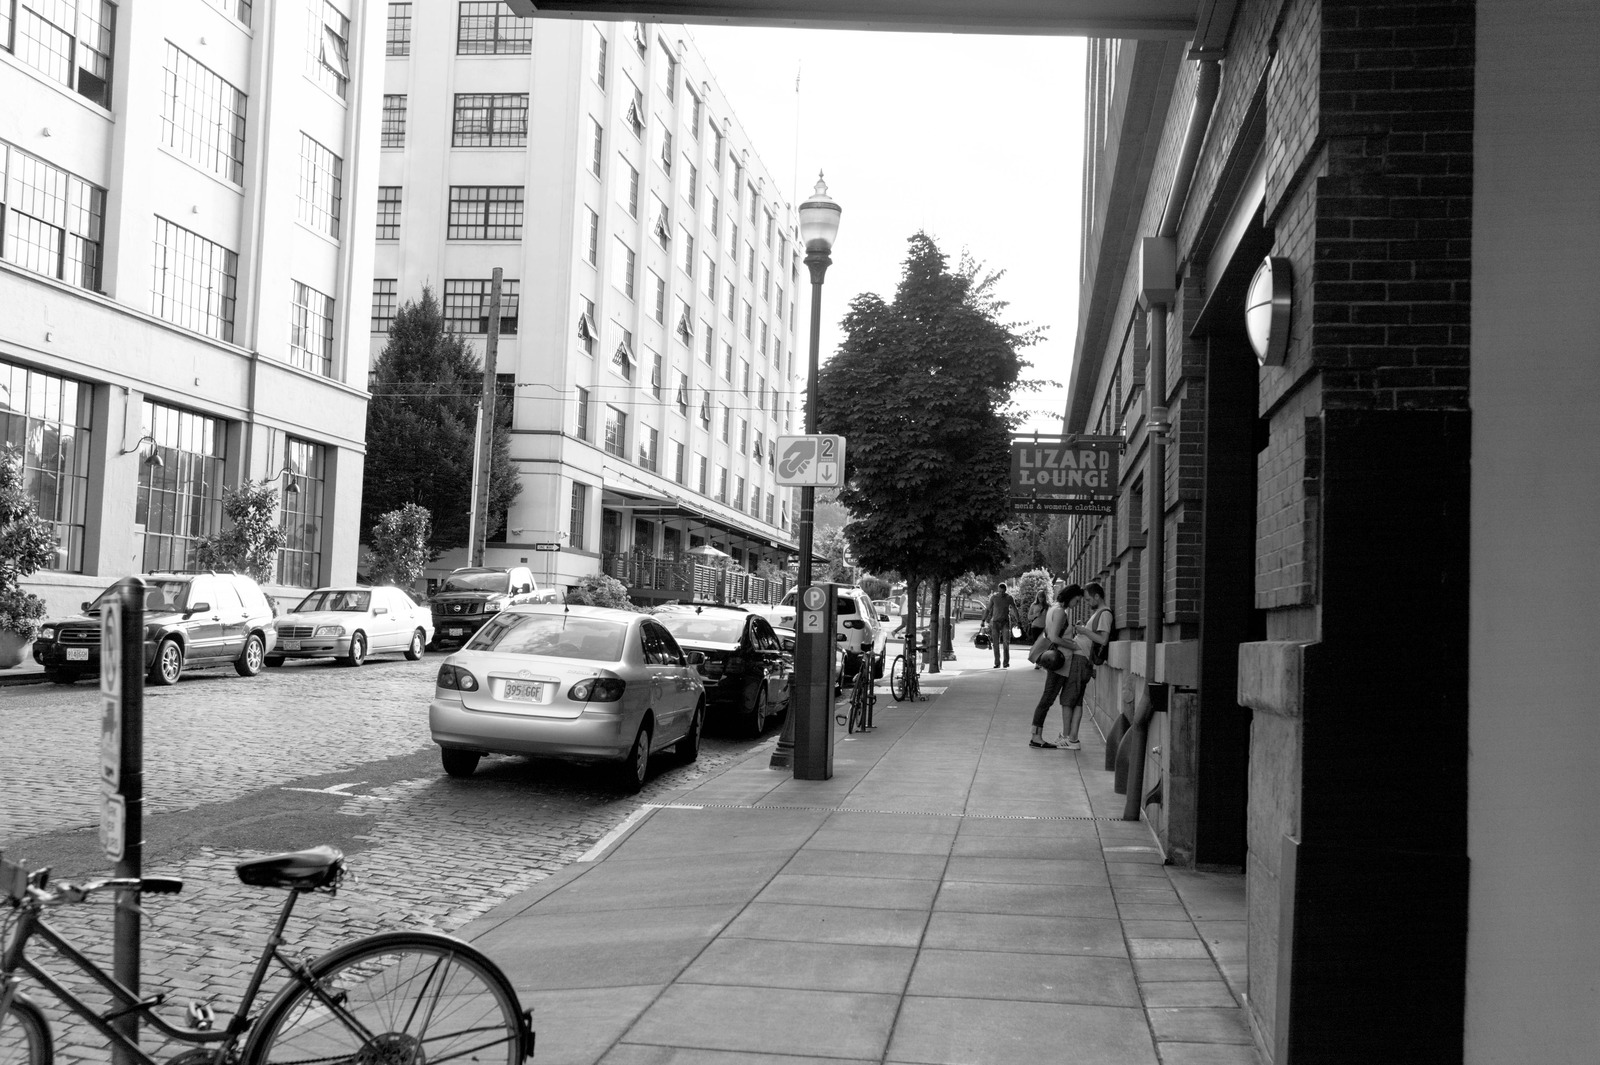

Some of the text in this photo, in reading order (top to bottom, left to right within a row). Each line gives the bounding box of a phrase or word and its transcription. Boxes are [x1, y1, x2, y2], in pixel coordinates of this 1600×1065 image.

[822, 438, 834, 458] 2
[1020, 449, 1109, 469] LIZARD
[1019, 470, 1108, 487] LOUNGE
[1014, 502, 1034, 510] men's
[1044, 502, 1073, 511] women's
[1075, 503, 1111, 513] clothing
[810, 591, 820, 607] P
[808, 614, 818, 627] 2
[506, 684, 541, 698] 395 GGF
